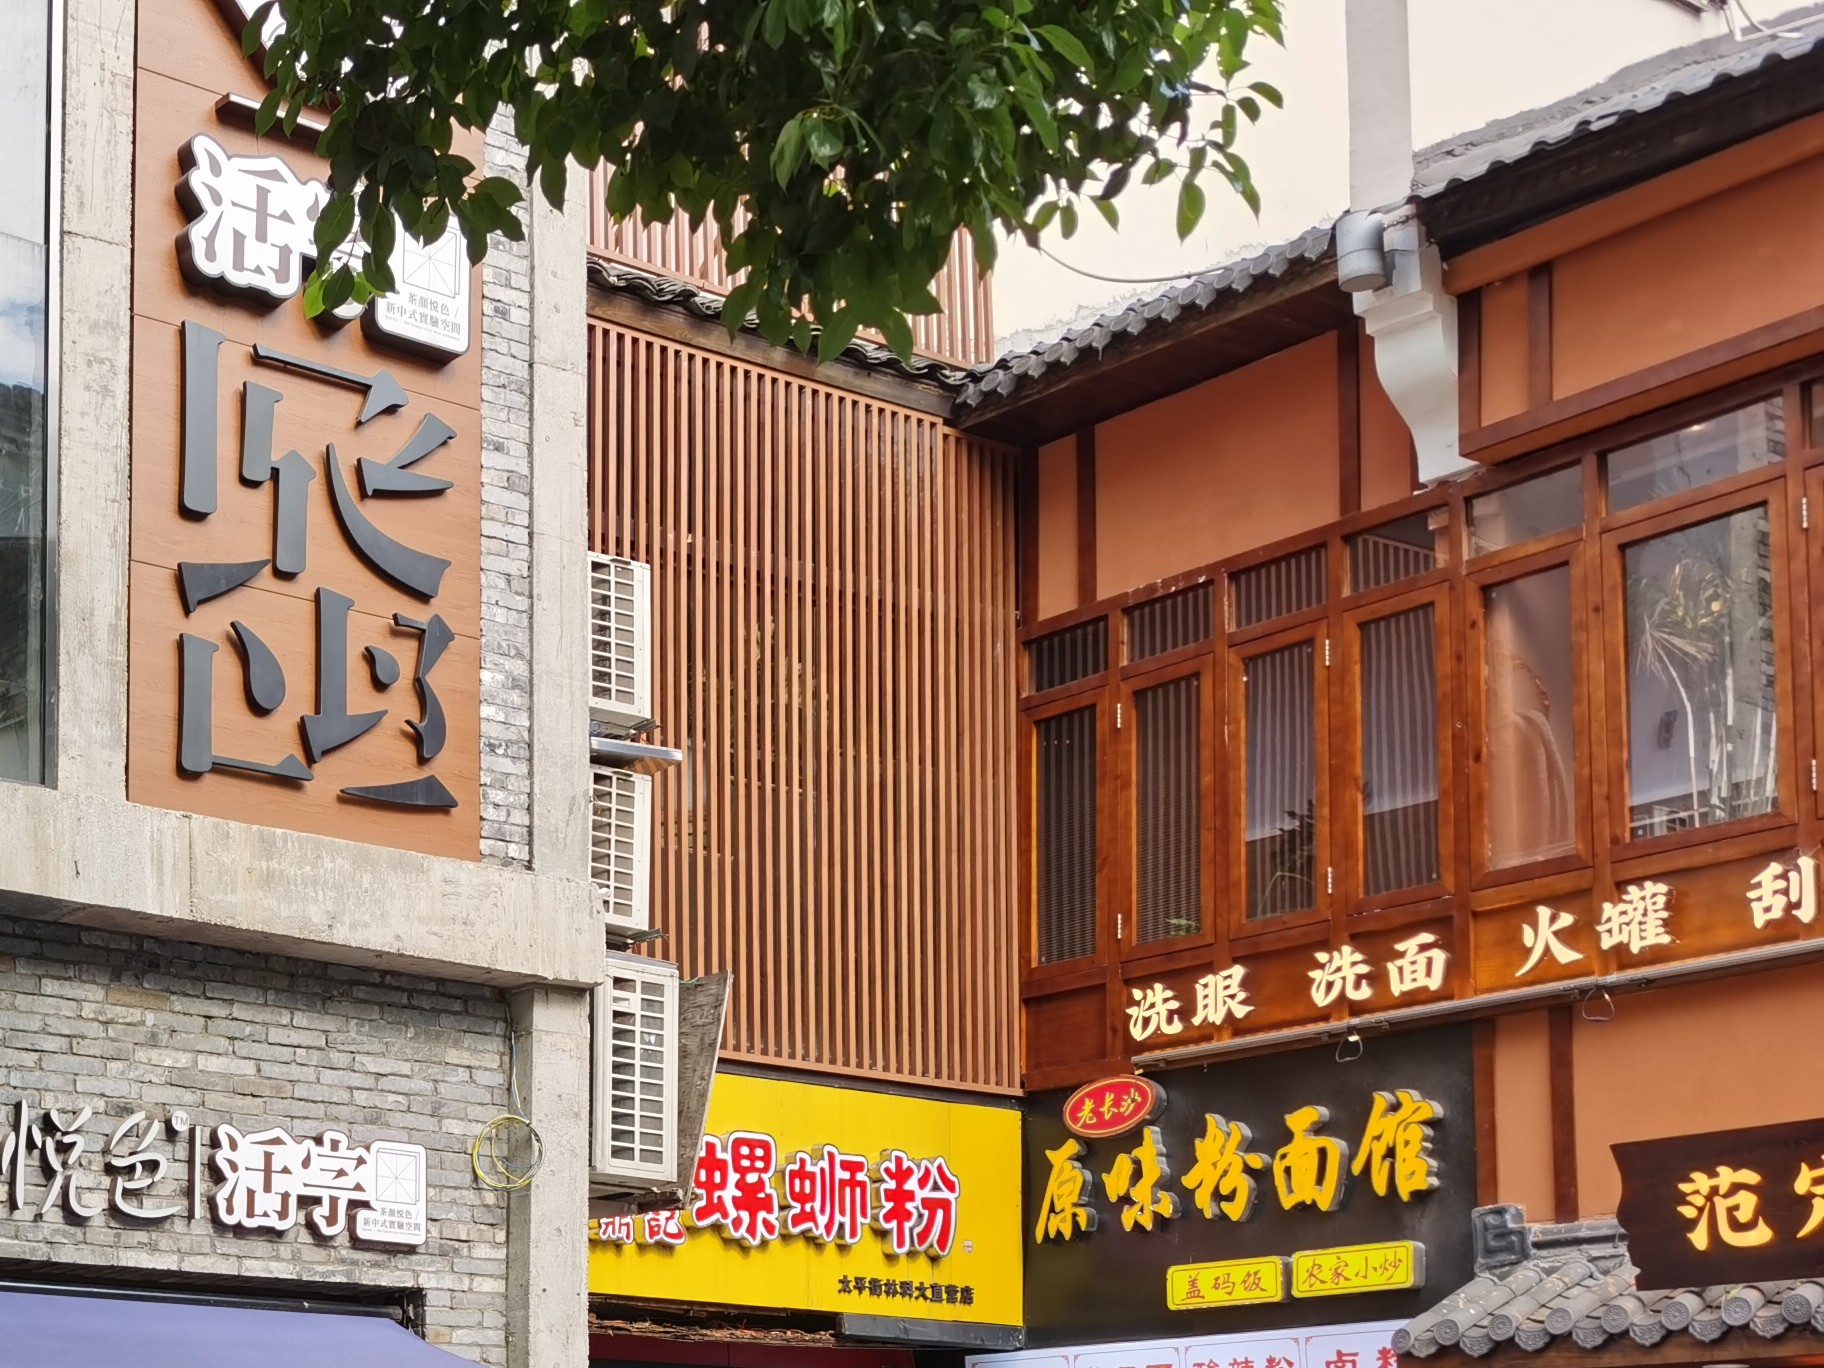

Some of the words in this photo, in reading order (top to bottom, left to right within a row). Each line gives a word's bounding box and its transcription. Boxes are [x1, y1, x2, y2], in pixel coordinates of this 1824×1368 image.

[1125, 964, 1255, 1041] 洗眼
[1308, 933, 1449, 1008] 洗面
[1515, 881, 1676, 976] 火罐
[1746, 857, 1817, 929] 刮
[174, 1114, 190, 1126] TM
[1035, 1090, 1440, 1246] 原味粉面馆
[220, 1128, 370, 1231] 活字
[693, 1130, 960, 1256] 螺蛳粉
[1181, 1269, 1269, 1302] 盖码饭
[1302, 1250, 1404, 1289] 农家小炒
